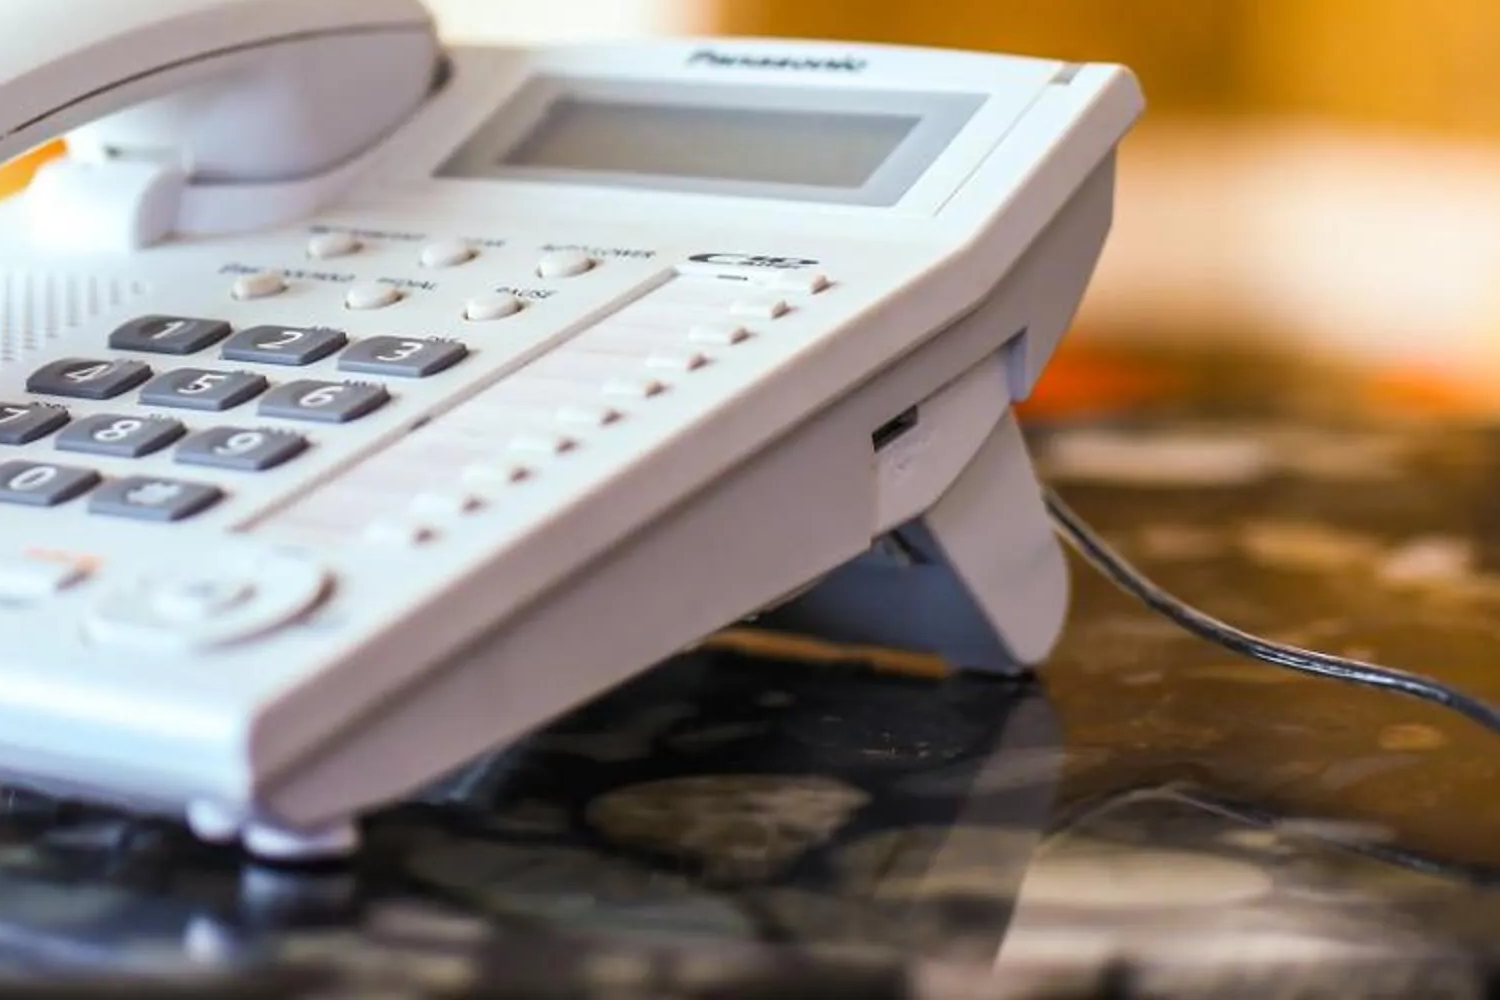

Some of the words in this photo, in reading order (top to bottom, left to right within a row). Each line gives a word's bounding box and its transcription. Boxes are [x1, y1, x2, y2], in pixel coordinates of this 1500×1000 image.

[151, 320, 186, 340] 1
[256, 331, 304, 350] 2
[376, 341, 423, 362] 3
[64, 363, 110, 384] 4
[177, 374, 227, 395] 5
[300, 385, 344, 408] 6
[93, 418, 143, 441] 8
[214, 431, 264, 454] 9
[8, 465, 58, 491] 0
